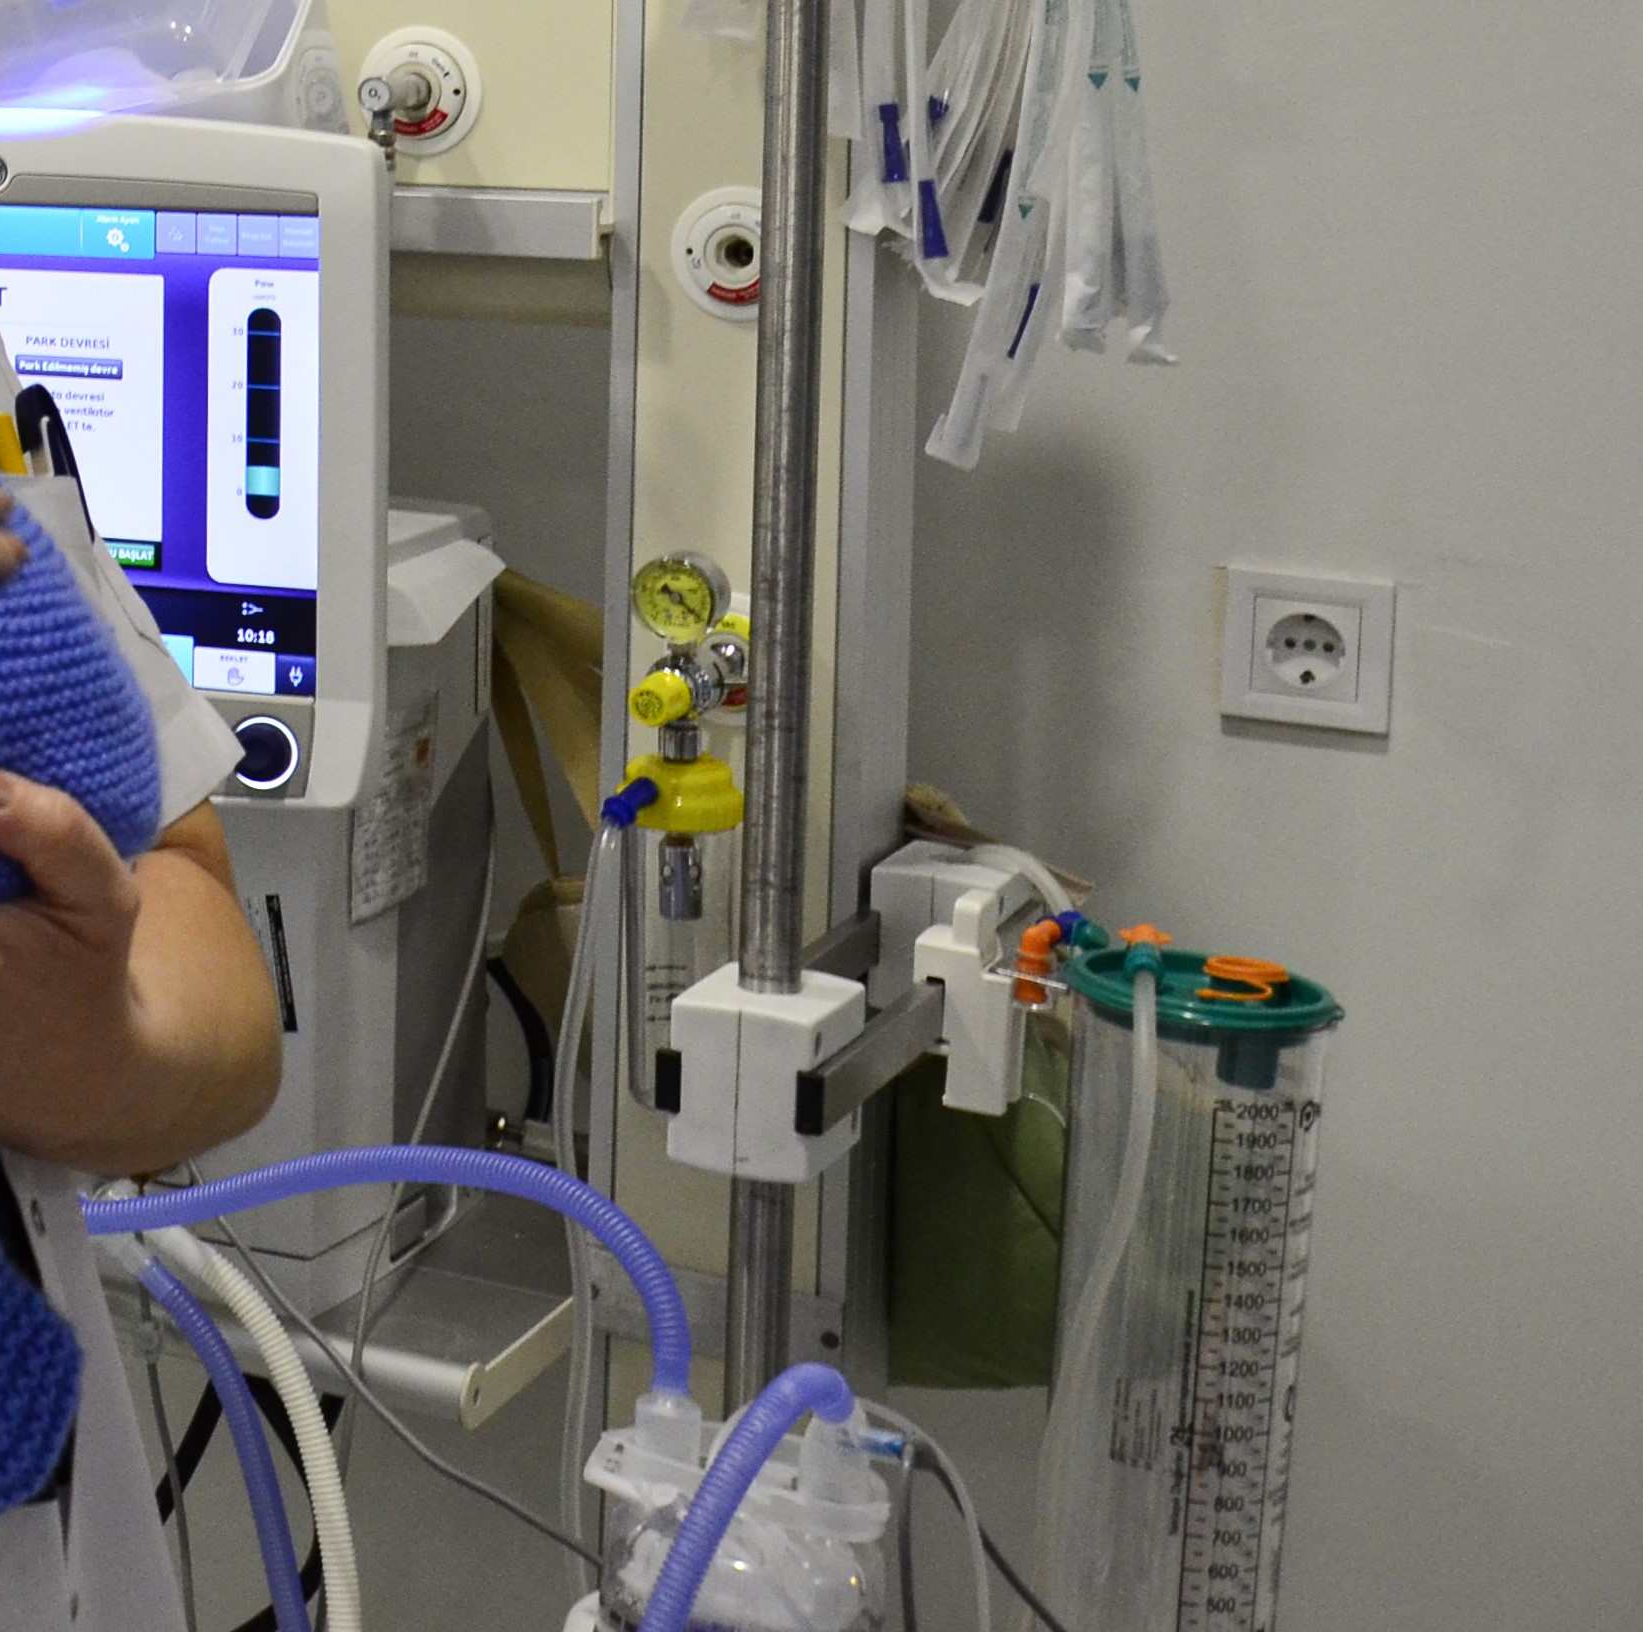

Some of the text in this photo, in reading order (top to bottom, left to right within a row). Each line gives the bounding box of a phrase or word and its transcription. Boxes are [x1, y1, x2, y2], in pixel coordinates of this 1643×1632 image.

[26, 335, 111, 350] PARK DEVRESİ
[19, 359, 41, 371] Park
[232, 381, 244, 390] 20
[65, 391, 105, 401] devresi
[232, 434, 243, 444] 10
[118, 550, 154, 563] BAŞLAT
[1235, 1132, 1278, 1149] 1900
[1233, 1164, 1275, 1181] 1800
[1231, 1197, 1273, 1214] 1700
[1227, 1260, 1266, 1278] 1500
[1224, 1293, 1265, 1310] 1400
